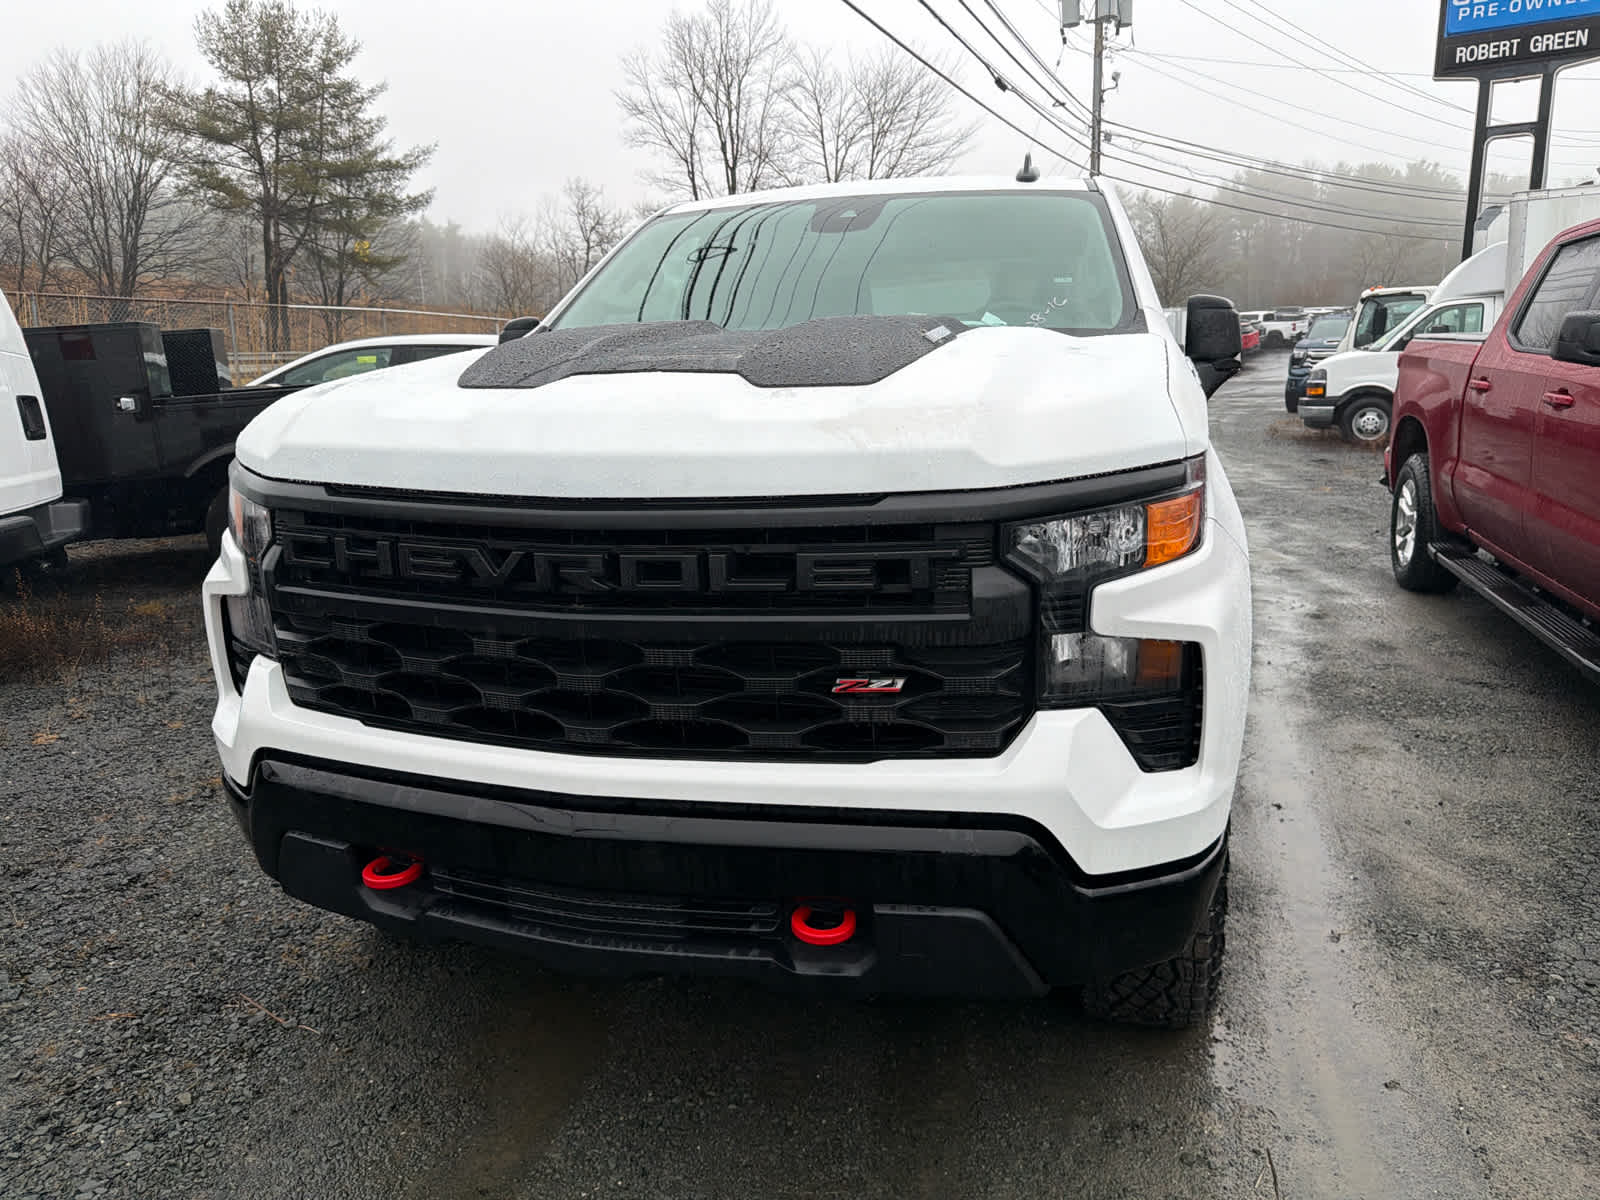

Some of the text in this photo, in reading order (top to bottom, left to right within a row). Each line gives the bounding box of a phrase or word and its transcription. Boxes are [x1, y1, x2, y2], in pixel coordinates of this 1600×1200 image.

[1458, 0, 1590, 20] PRE-OWN
[1455, 29, 1589, 63] ROBERT GREEN
[282, 530, 965, 594] CHEVROLET
[832, 678, 905, 693] Z71
